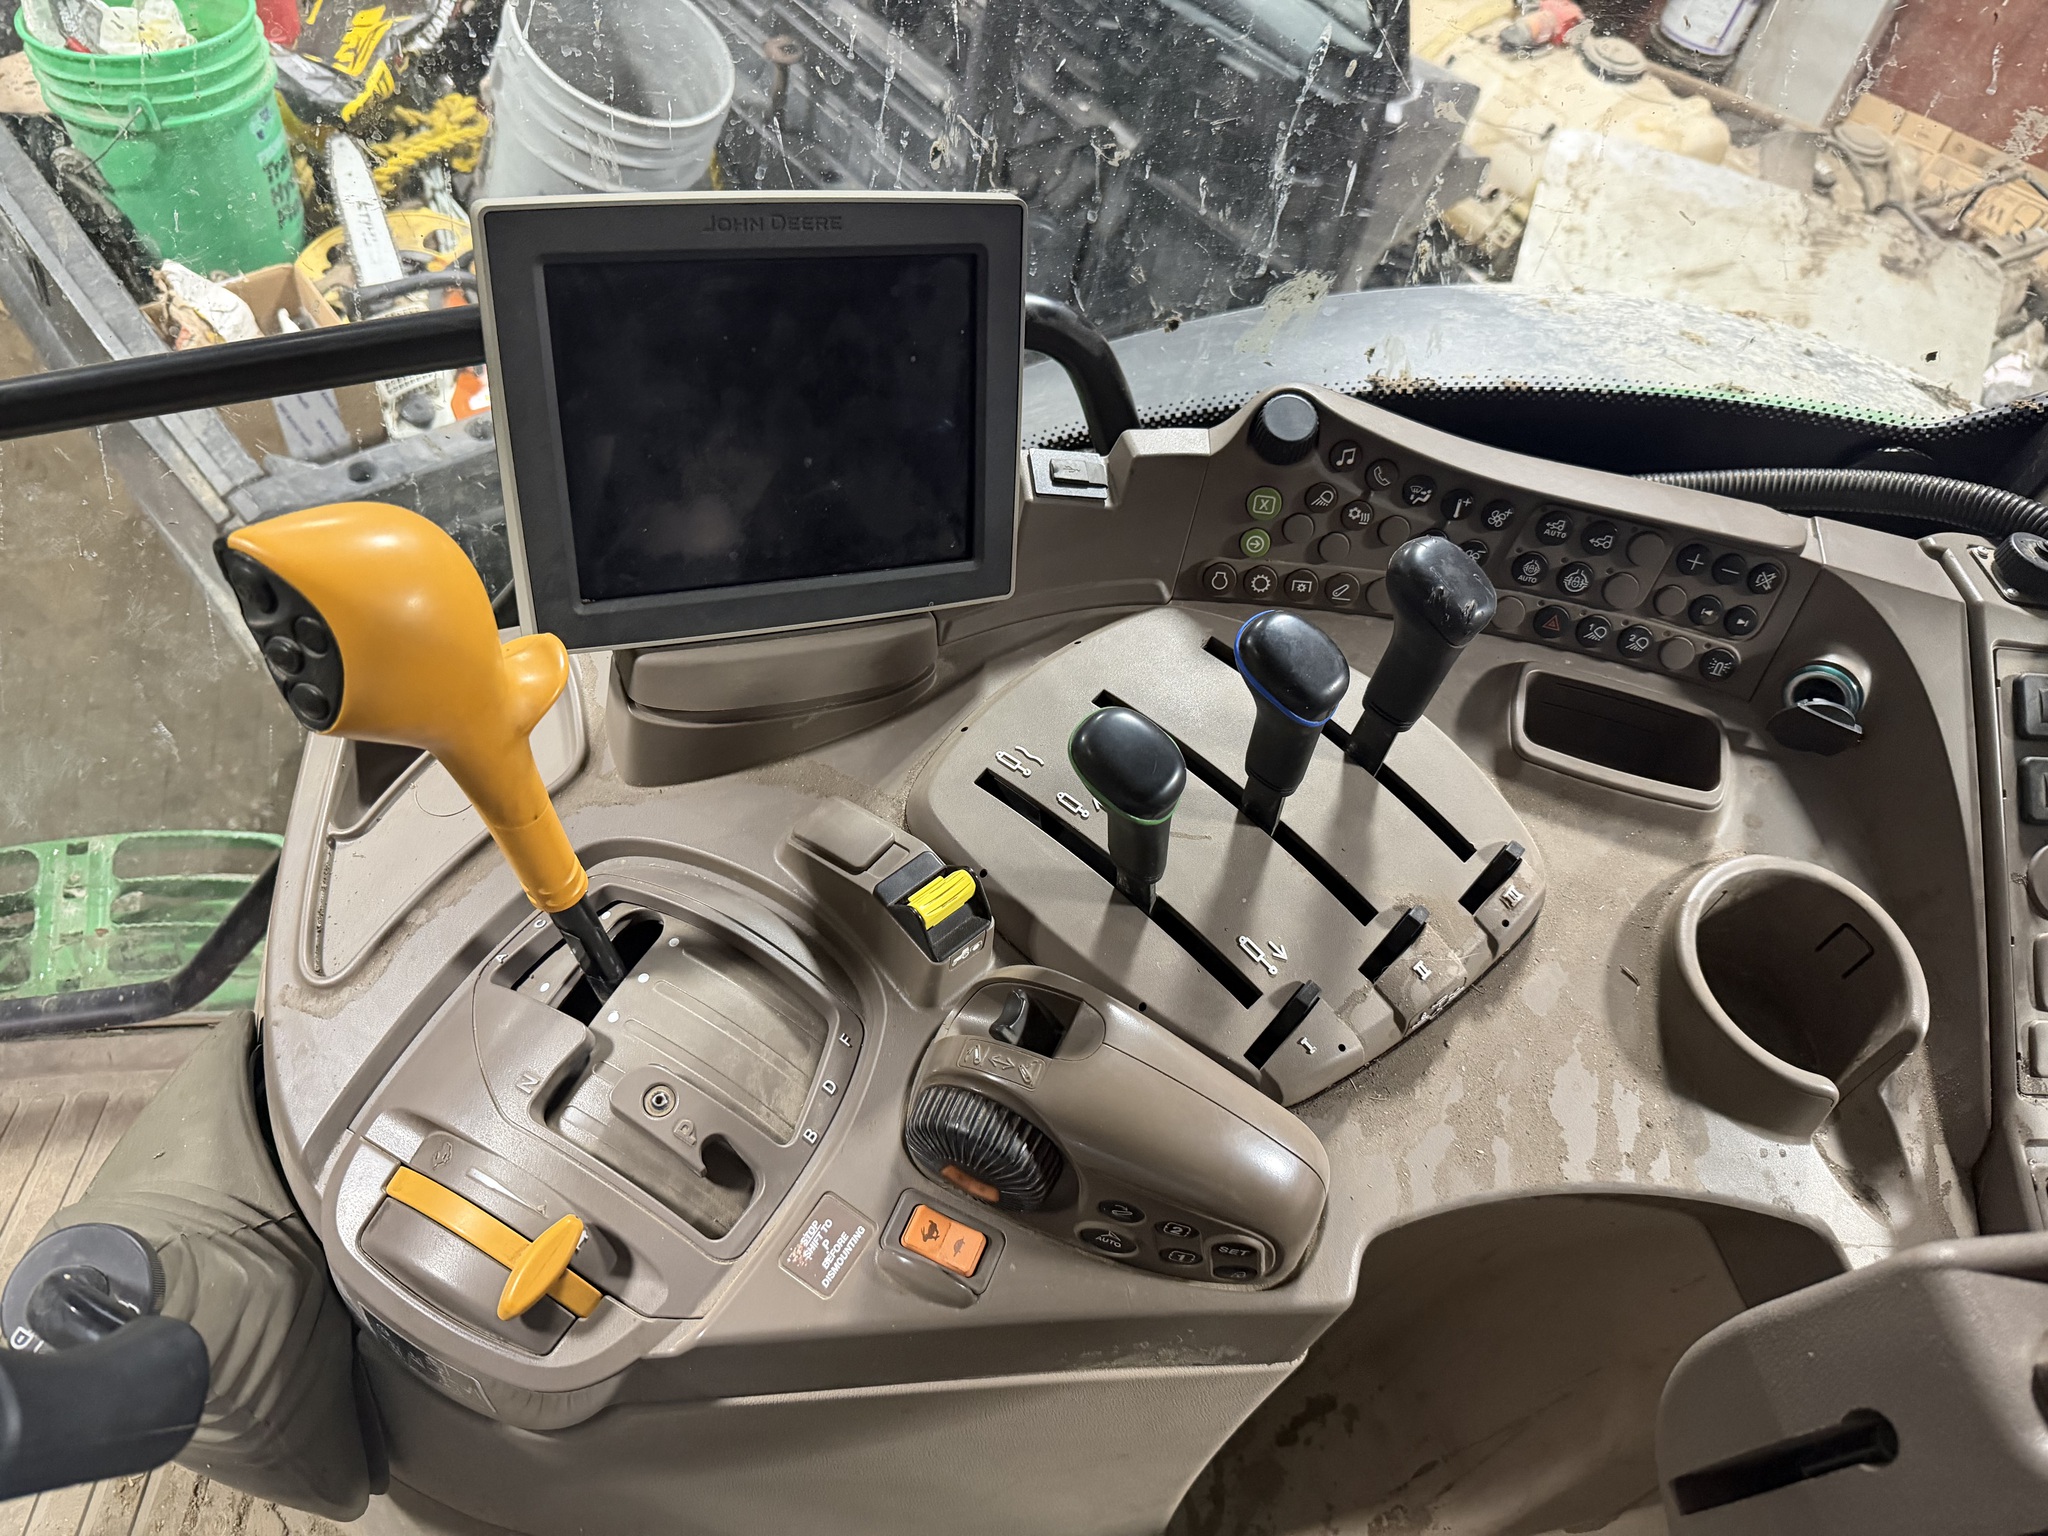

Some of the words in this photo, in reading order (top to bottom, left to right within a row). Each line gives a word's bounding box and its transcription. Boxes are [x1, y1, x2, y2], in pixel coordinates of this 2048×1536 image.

[702, 214, 764, 232] JOHN
[771, 213, 843, 231] DEERE
[1543, 529, 1567, 539] AUTO
[1517, 574, 1538, 584] AUTO
[1629, 634, 1636, 642] 2
[495, 953, 508, 964] A
[839, 1033, 852, 1047] F
[516, 1073, 541, 1095] N
[822, 1079, 837, 1096] D
[673, 1119, 697, 1147] P
[803, 1128, 818, 1144] B
[800, 1219, 819, 1247] STOP
[1170, 1226, 1183, 1235] 2
[803, 1231, 824, 1259] SHIFT
[820, 1219, 833, 1233] TO
[1095, 1235, 1122, 1248] AUTO
[821, 1231, 849, 1270] BEFORE
[821, 1225, 866, 1288] DISMOUNTING
[1218, 1246, 1250, 1256] SET
